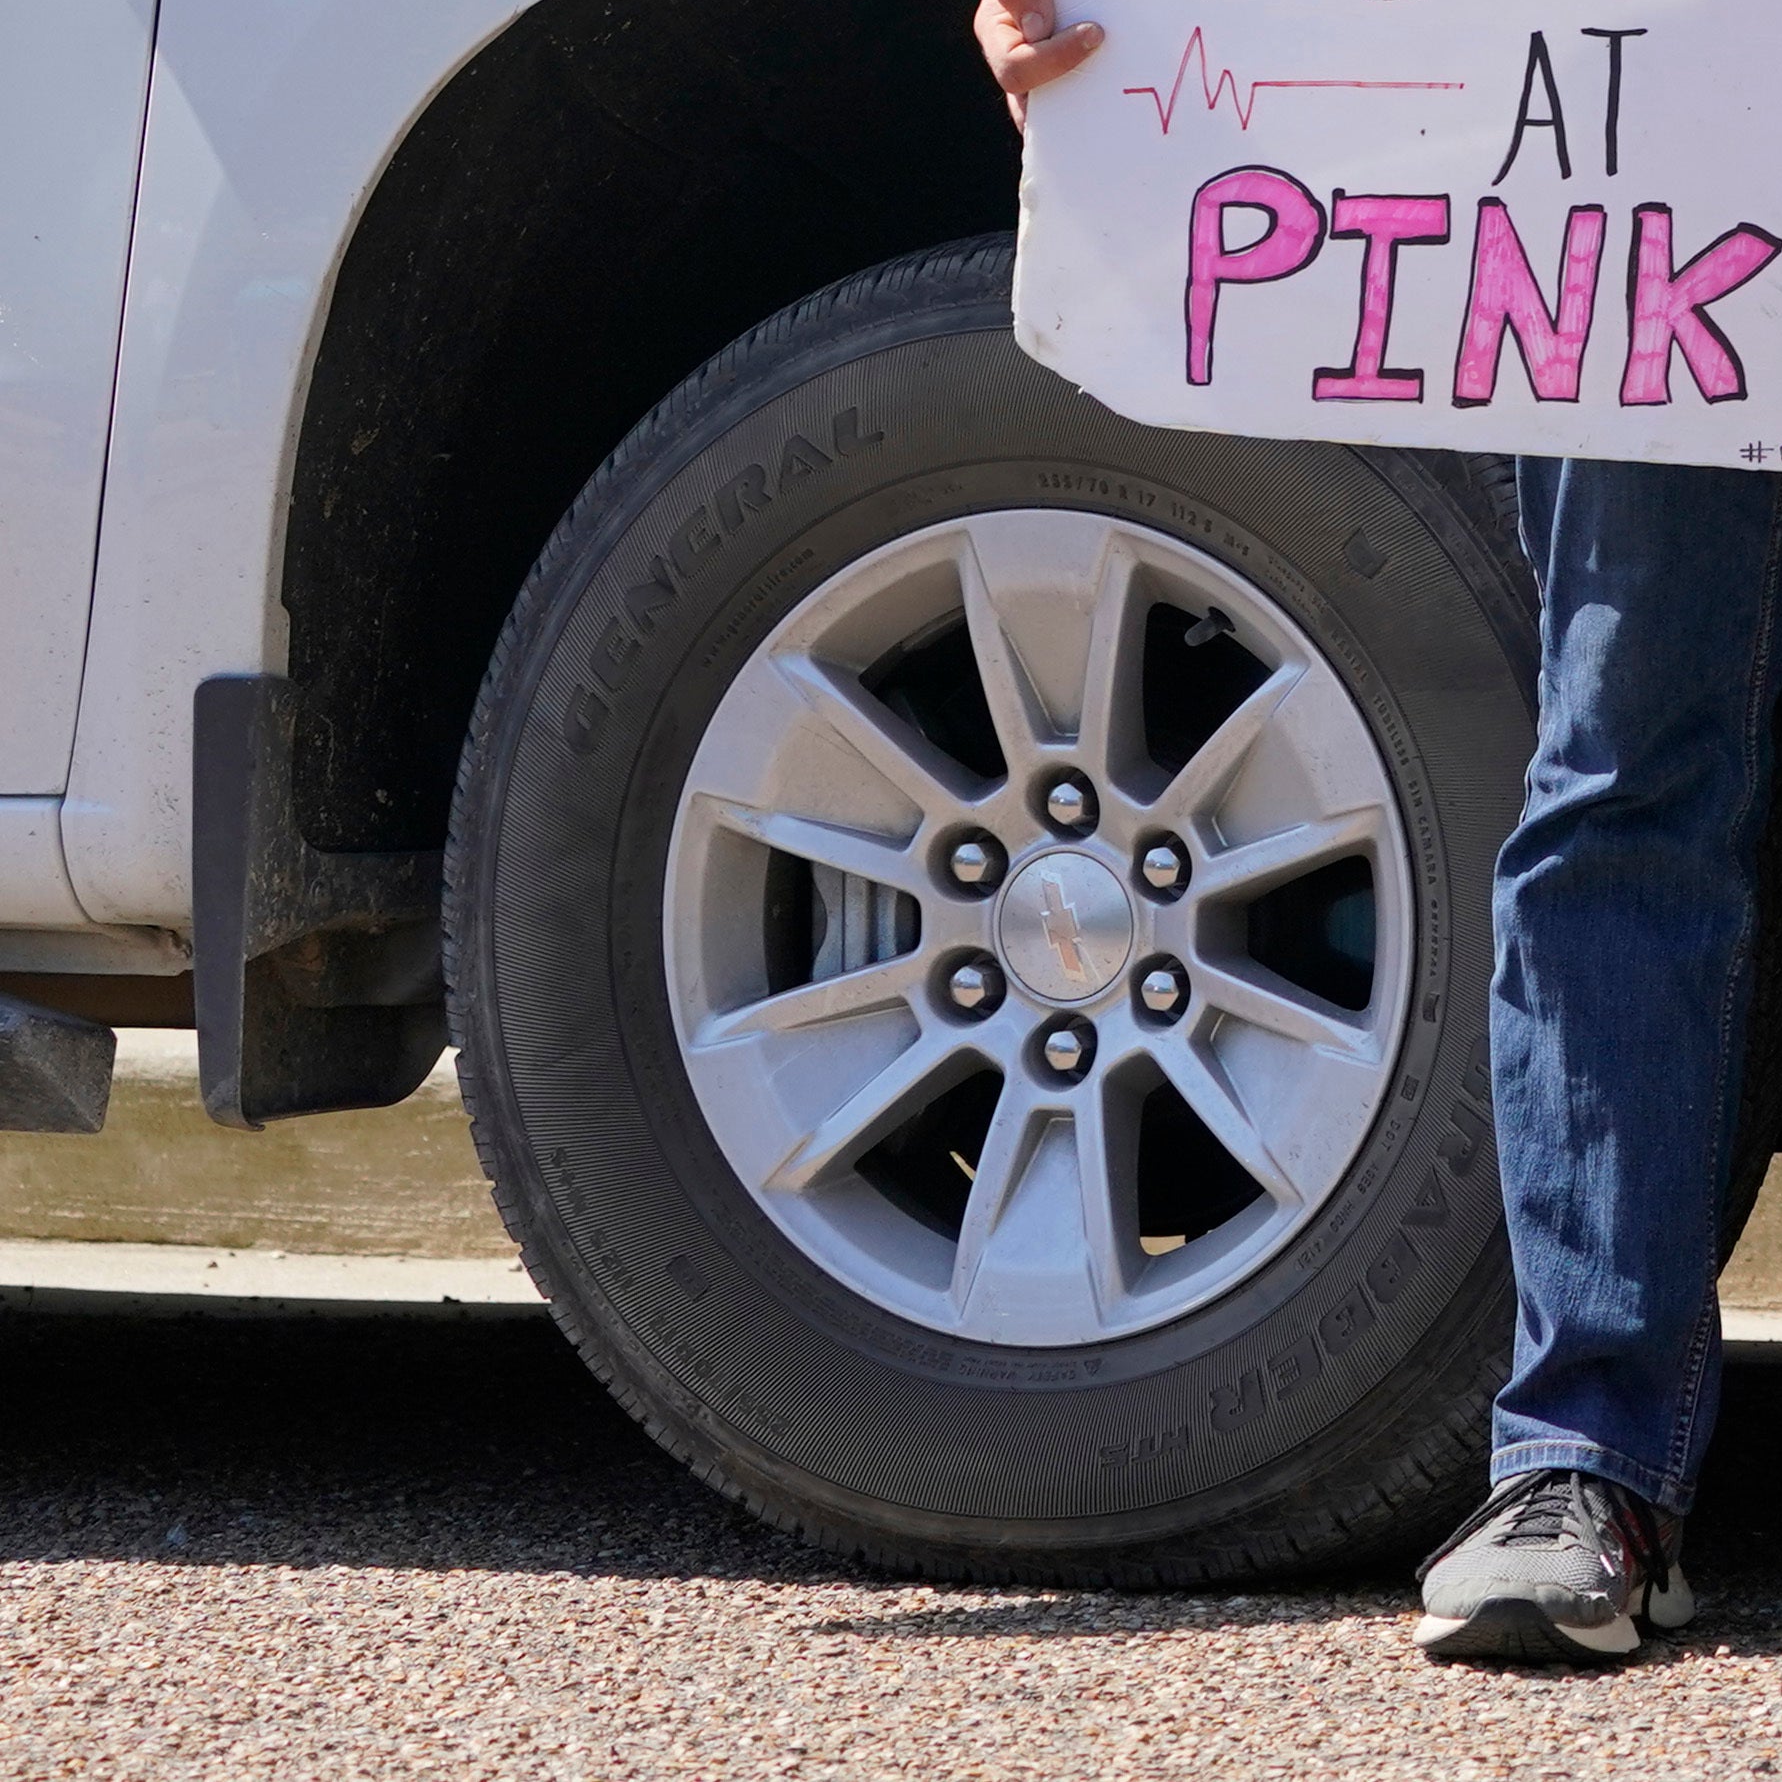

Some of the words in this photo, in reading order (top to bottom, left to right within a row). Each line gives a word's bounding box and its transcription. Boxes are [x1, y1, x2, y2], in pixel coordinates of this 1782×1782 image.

[1490, 27, 1648, 187] AT
[1185, 165, 1782, 408] PINK
[563, 405, 886, 757] GENERAL
